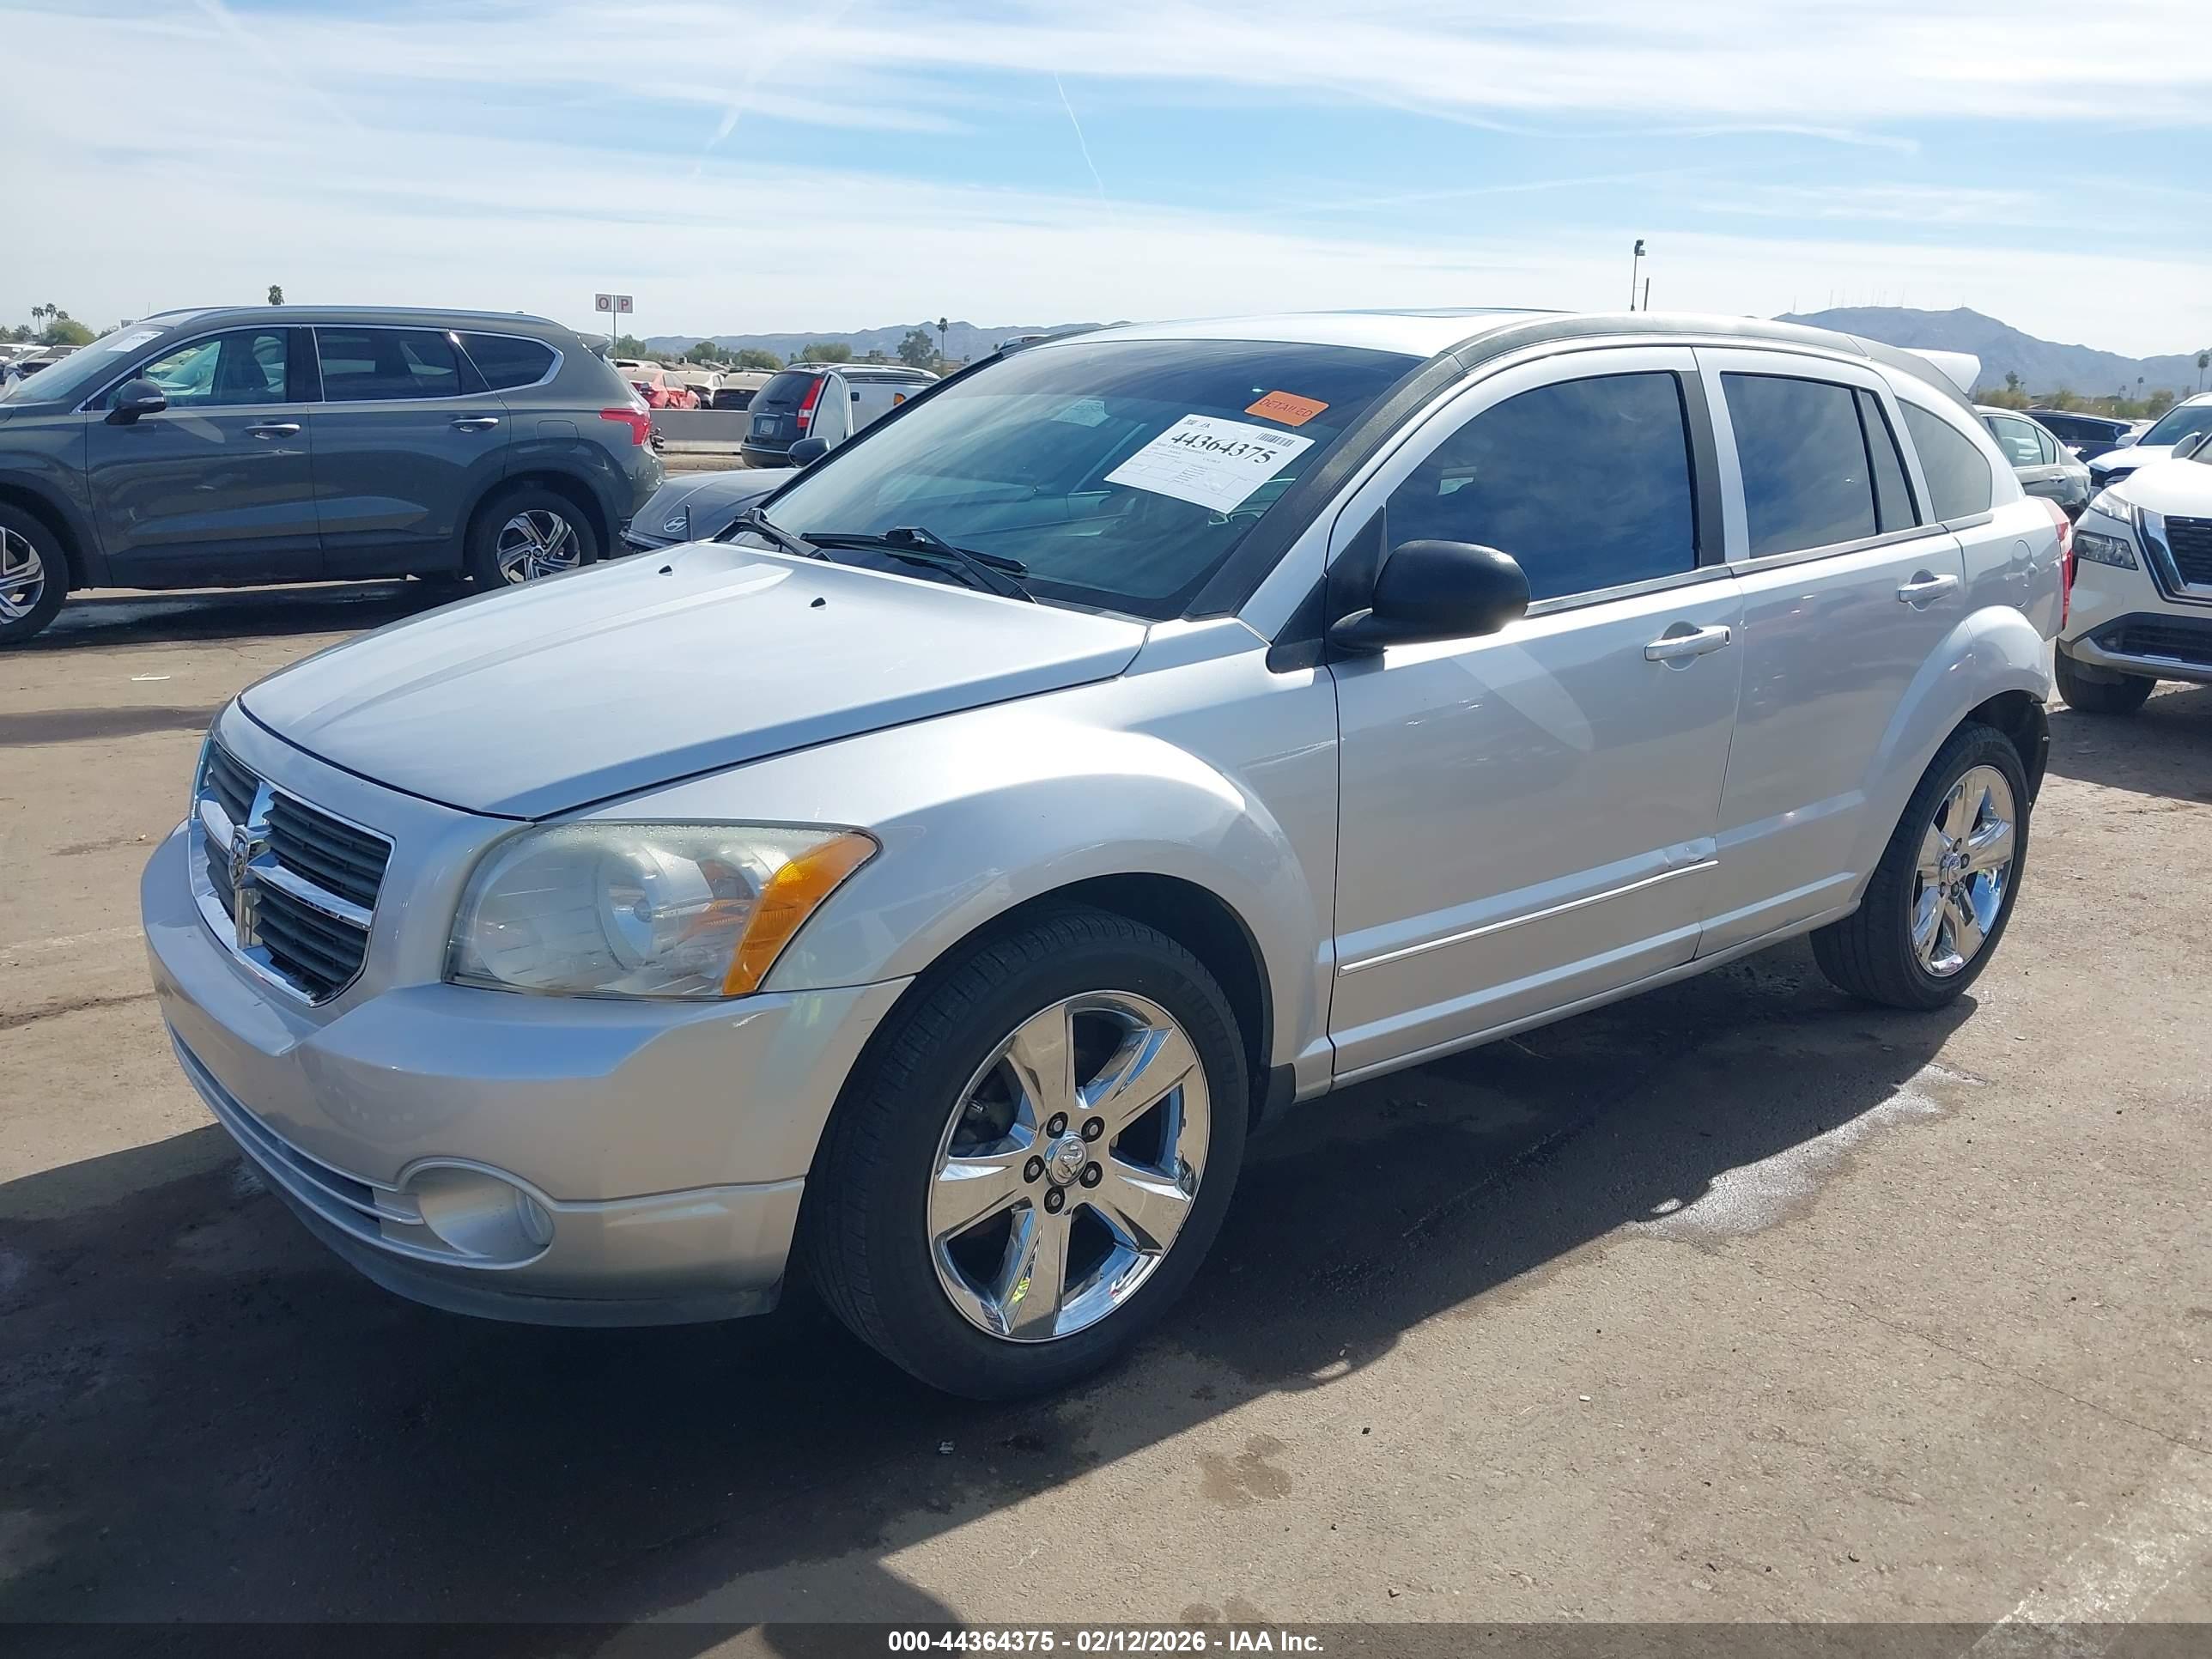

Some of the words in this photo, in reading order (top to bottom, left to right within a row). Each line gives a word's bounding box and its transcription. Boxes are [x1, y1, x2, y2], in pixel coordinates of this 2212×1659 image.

[599, 297, 609, 309] O
[622, 299, 629, 310] P
[1259, 398, 1313, 417] DETAILED
[1170, 432, 1279, 464] 44364375
